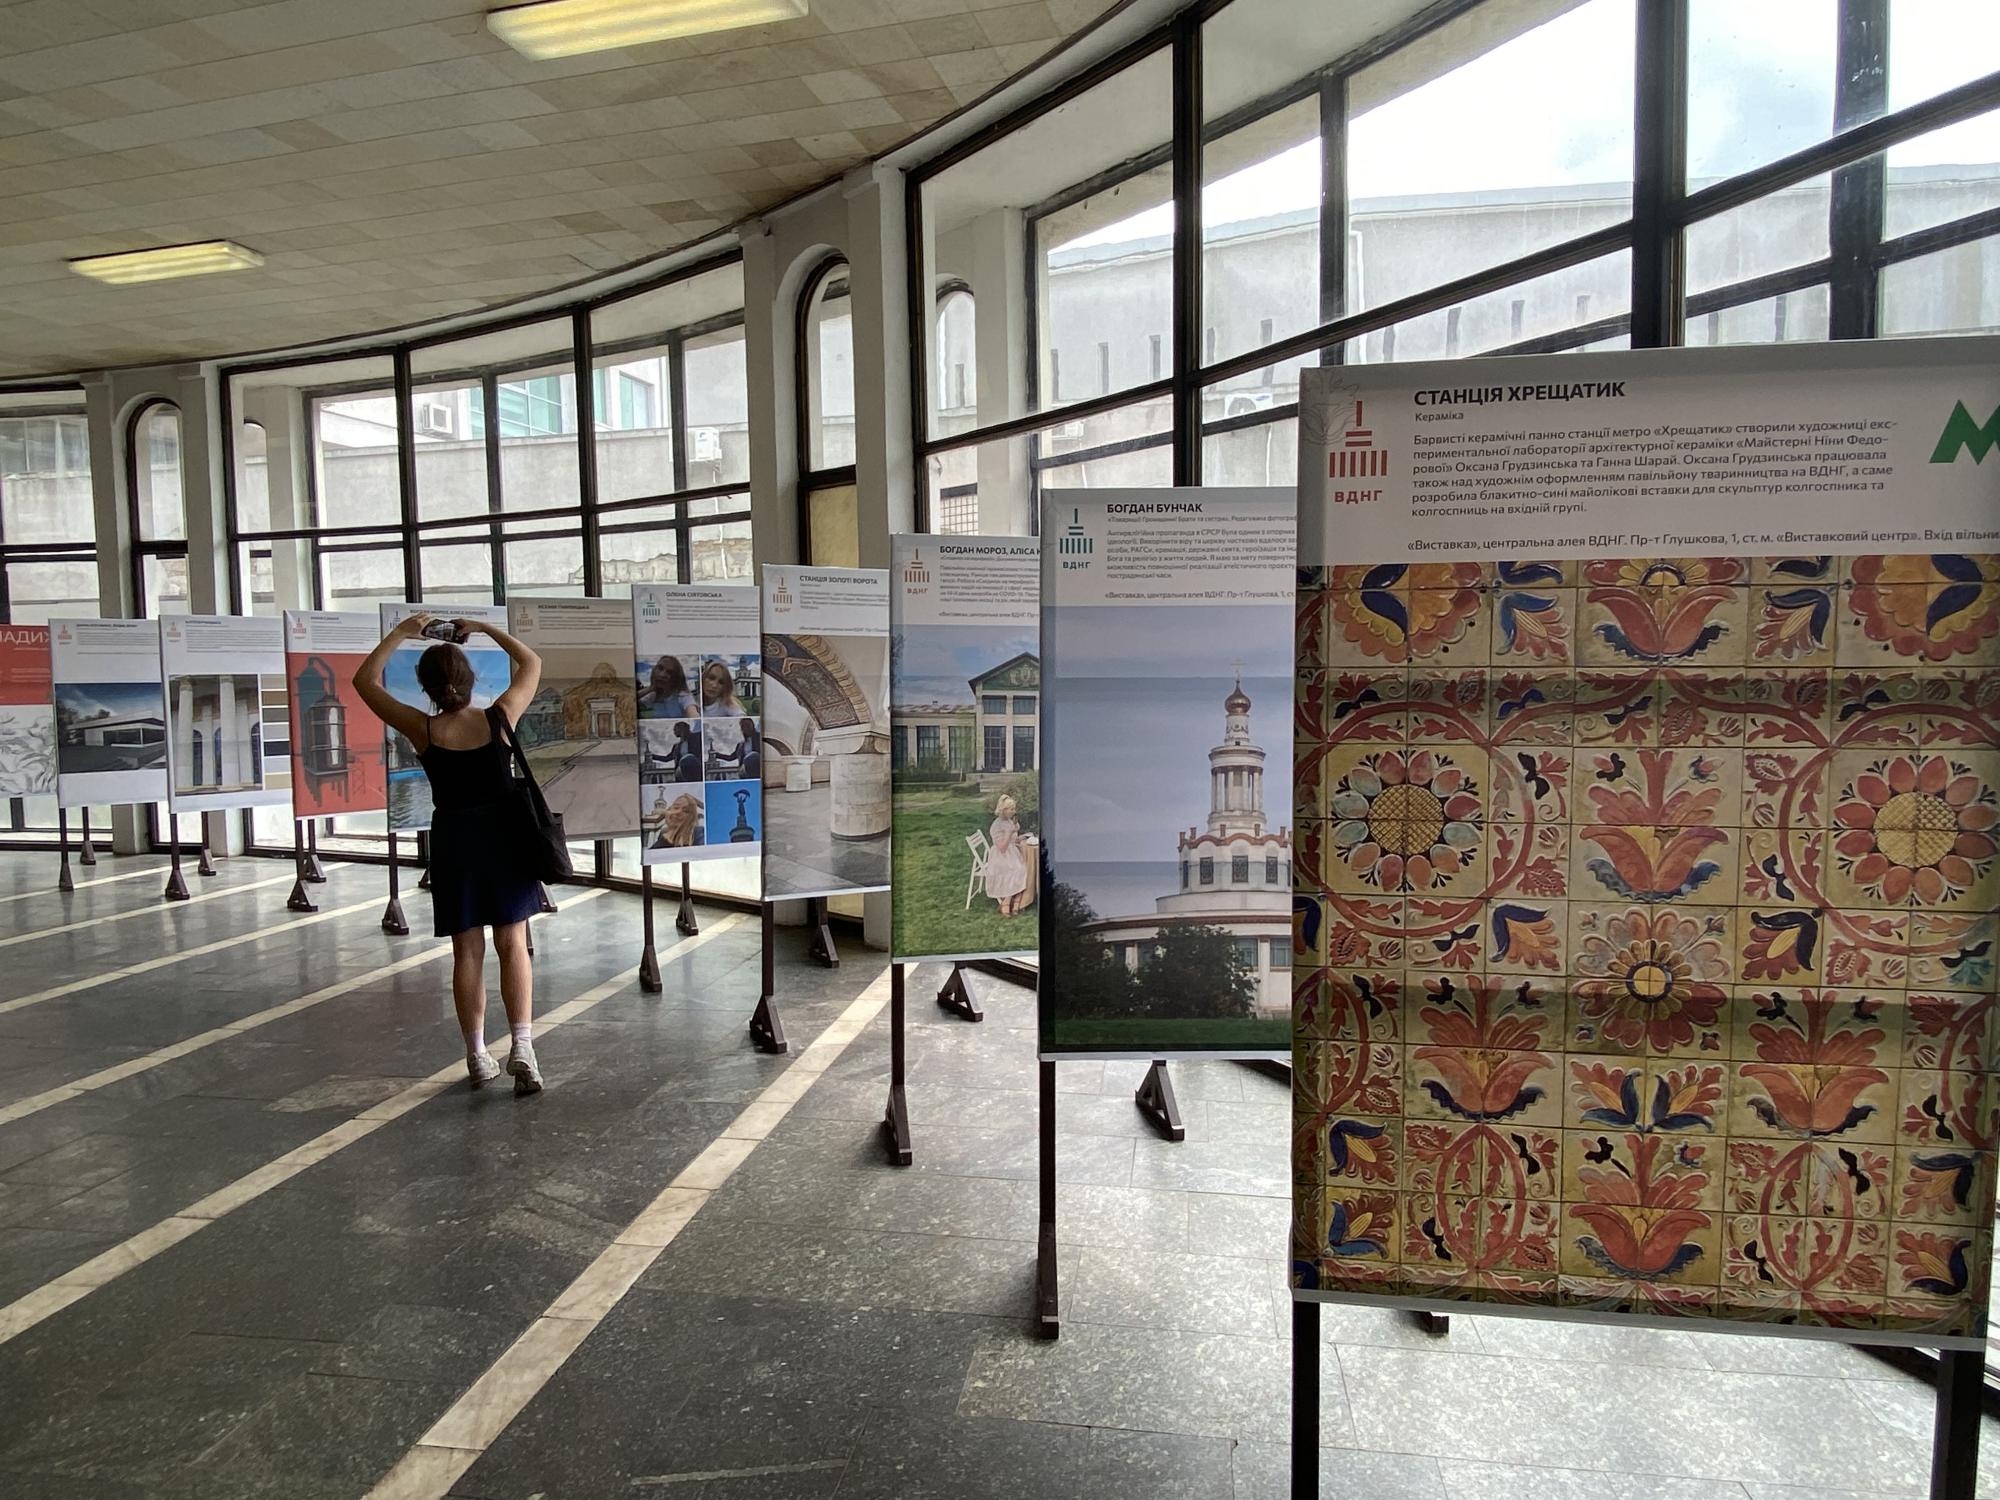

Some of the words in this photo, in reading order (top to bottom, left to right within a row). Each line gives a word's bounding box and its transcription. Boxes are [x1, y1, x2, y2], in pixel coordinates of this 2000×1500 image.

[1414, 387, 1503, 405] СТАНЦІЯ
[1508, 381, 1626, 402] ХРЕЩАТИК
[1415, 411, 1465, 422] Кераміка
[1414, 432, 1466, 446] Барвисті
[1468, 430, 1526, 444] керамічні
[1528, 432, 1565, 440] панно
[1568, 427, 1609, 440] станції
[1612, 429, 1651, 439] метро
[1654, 425, 1732, 437] «Хрещатик»
[1736, 424, 1796, 435] створили
[1798, 419, 1867, 433] художниці
[1870, 421, 1898, 429] екс-
[1413, 445, 1510, 460] периментальної
[1512, 443, 1586, 457] лабораторії
[1589, 440, 1674, 455] архітектурної
[1677, 439, 1734, 452] кераміки
[1737, 436, 1811, 449] «Майстерні
[1814, 435, 1844, 446] Ніни
[1846, 434, 1889, 446] Федо-
[1413, 461, 1453, 475] рової»
[1455, 461, 1499, 471] Оксана
[1502, 459, 1578, 472] Грудзинська
[1581, 460, 1594, 468] та
[1596, 457, 1631, 467] Ганна
[1634, 455, 1680, 468] Шарай.
[1683, 454, 1729, 465] Оксана
[1732, 453, 1812, 465] Грудзинська
[1814, 452, 1887, 463] працювала
[1413, 479, 1449, 488] також
[1451, 478, 1473, 488] над
[1475, 474, 1534, 487] художнім
[1536, 473, 1625, 485] оформленням
[1628, 470, 1697, 482] павільйону
[1700, 470, 1788, 481] тваринництва
[1792, 469, 1807, 477] на
[1809, 465, 1849, 478] ВДНГ,
[1862, 467, 1893, 475] саме
[1334, 490, 1383, 504] ВДНГ
[1412, 491, 1477, 504] розробила
[1480, 487, 1568, 500] блакитно-сині
[1570, 485, 1638, 498] майолікові
[1641, 487, 1691, 496] вставки
[1692, 486, 1715, 496] для
[1718, 485, 1782, 495] скульптур
[1785, 483, 1868, 492] колгоспника
[1871, 482, 1884, 490] та
[1107, 504, 1154, 514] БОГДАН
[1156, 504, 1203, 514] БУНЧАК
[1412, 507, 1488, 517] колгоспниць
[1491, 507, 1505, 515] на
[1507, 503, 1550, 516] вхідній
[1553, 502, 1587, 515] групі.
[1408, 540, 1481, 551] «Виставка»,
[1483, 540, 1554, 551] центральна
[1557, 539, 1586, 547] алея
[1589, 536, 1627, 548] ВДНГ.
[1630, 535, 1660, 548] Пр-т
[1663, 535, 1728, 547] Глушкова,
[1731, 533, 1740, 545] 1,
[1777, 531, 1868, 543] «Виставковий
[1924, 530, 1952, 542] Вхід
[940, 546, 974, 554] БОГДАН
[976, 547, 1008, 555] МОРОЗ,
[1010, 547, 1035, 555] АЛІСА
[907, 587, 928, 595] ВДНГ
[0, 631, 48, 645] АДИ
